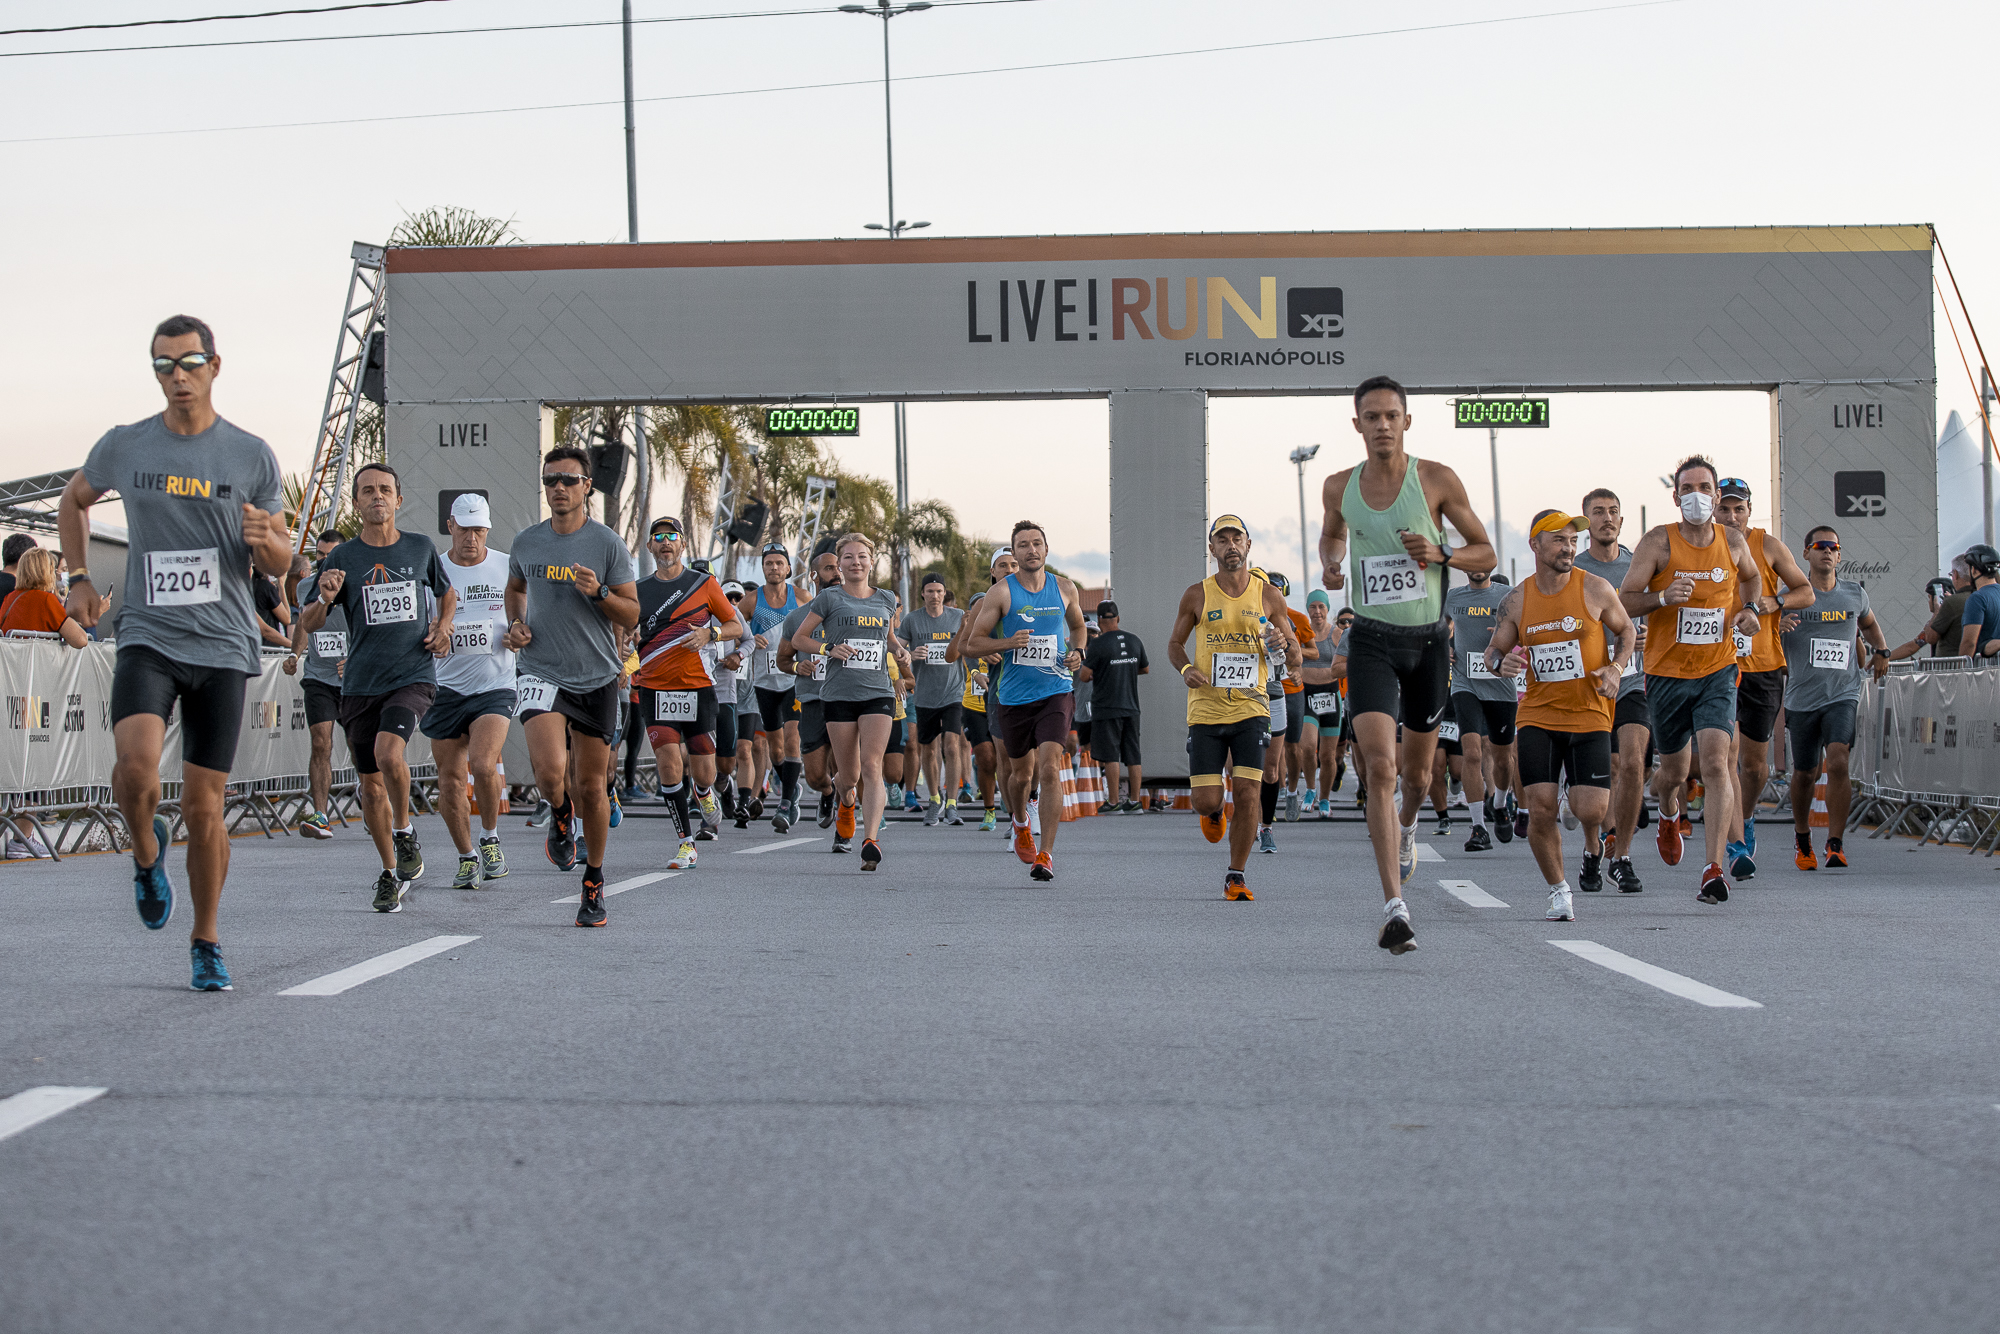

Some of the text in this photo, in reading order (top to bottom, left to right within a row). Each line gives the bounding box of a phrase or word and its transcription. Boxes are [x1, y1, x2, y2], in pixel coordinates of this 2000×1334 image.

[1300, 313, 1345, 338] XP
[1184, 348, 1345, 366] FLORIANÓPOLIS
[769, 410, 857, 431] 00:00:00
[1458, 402, 1546, 423] 00:00:07
[1833, 403, 1883, 428] LIVE!
[439, 423, 488, 447] LIVE!
[1846, 494, 1887, 518] XP
[1838, 560, 1890, 574] Michelob
[154, 569, 211, 592] 2204
[1368, 570, 1417, 593] 2263
[466, 592, 504, 601] MARATONA
[467, 584, 490, 594] MEIA
[371, 596, 412, 615] 2298
[655, 589, 683, 616] newpace
[1684, 621, 1718, 636] 2226
[318, 640, 343, 651] 2224
[454, 633, 488, 647] 2186
[1021, 647, 1051, 660] 2212
[1110, 657, 1138, 665] ORGANIZAÇÃO
[1815, 650, 1844, 663] 2222
[1537, 655, 1575, 673] 2225
[1218, 666, 1252, 679] 2247
[661, 702, 691, 714] 2019
[1313, 700, 1331, 710] 2194
